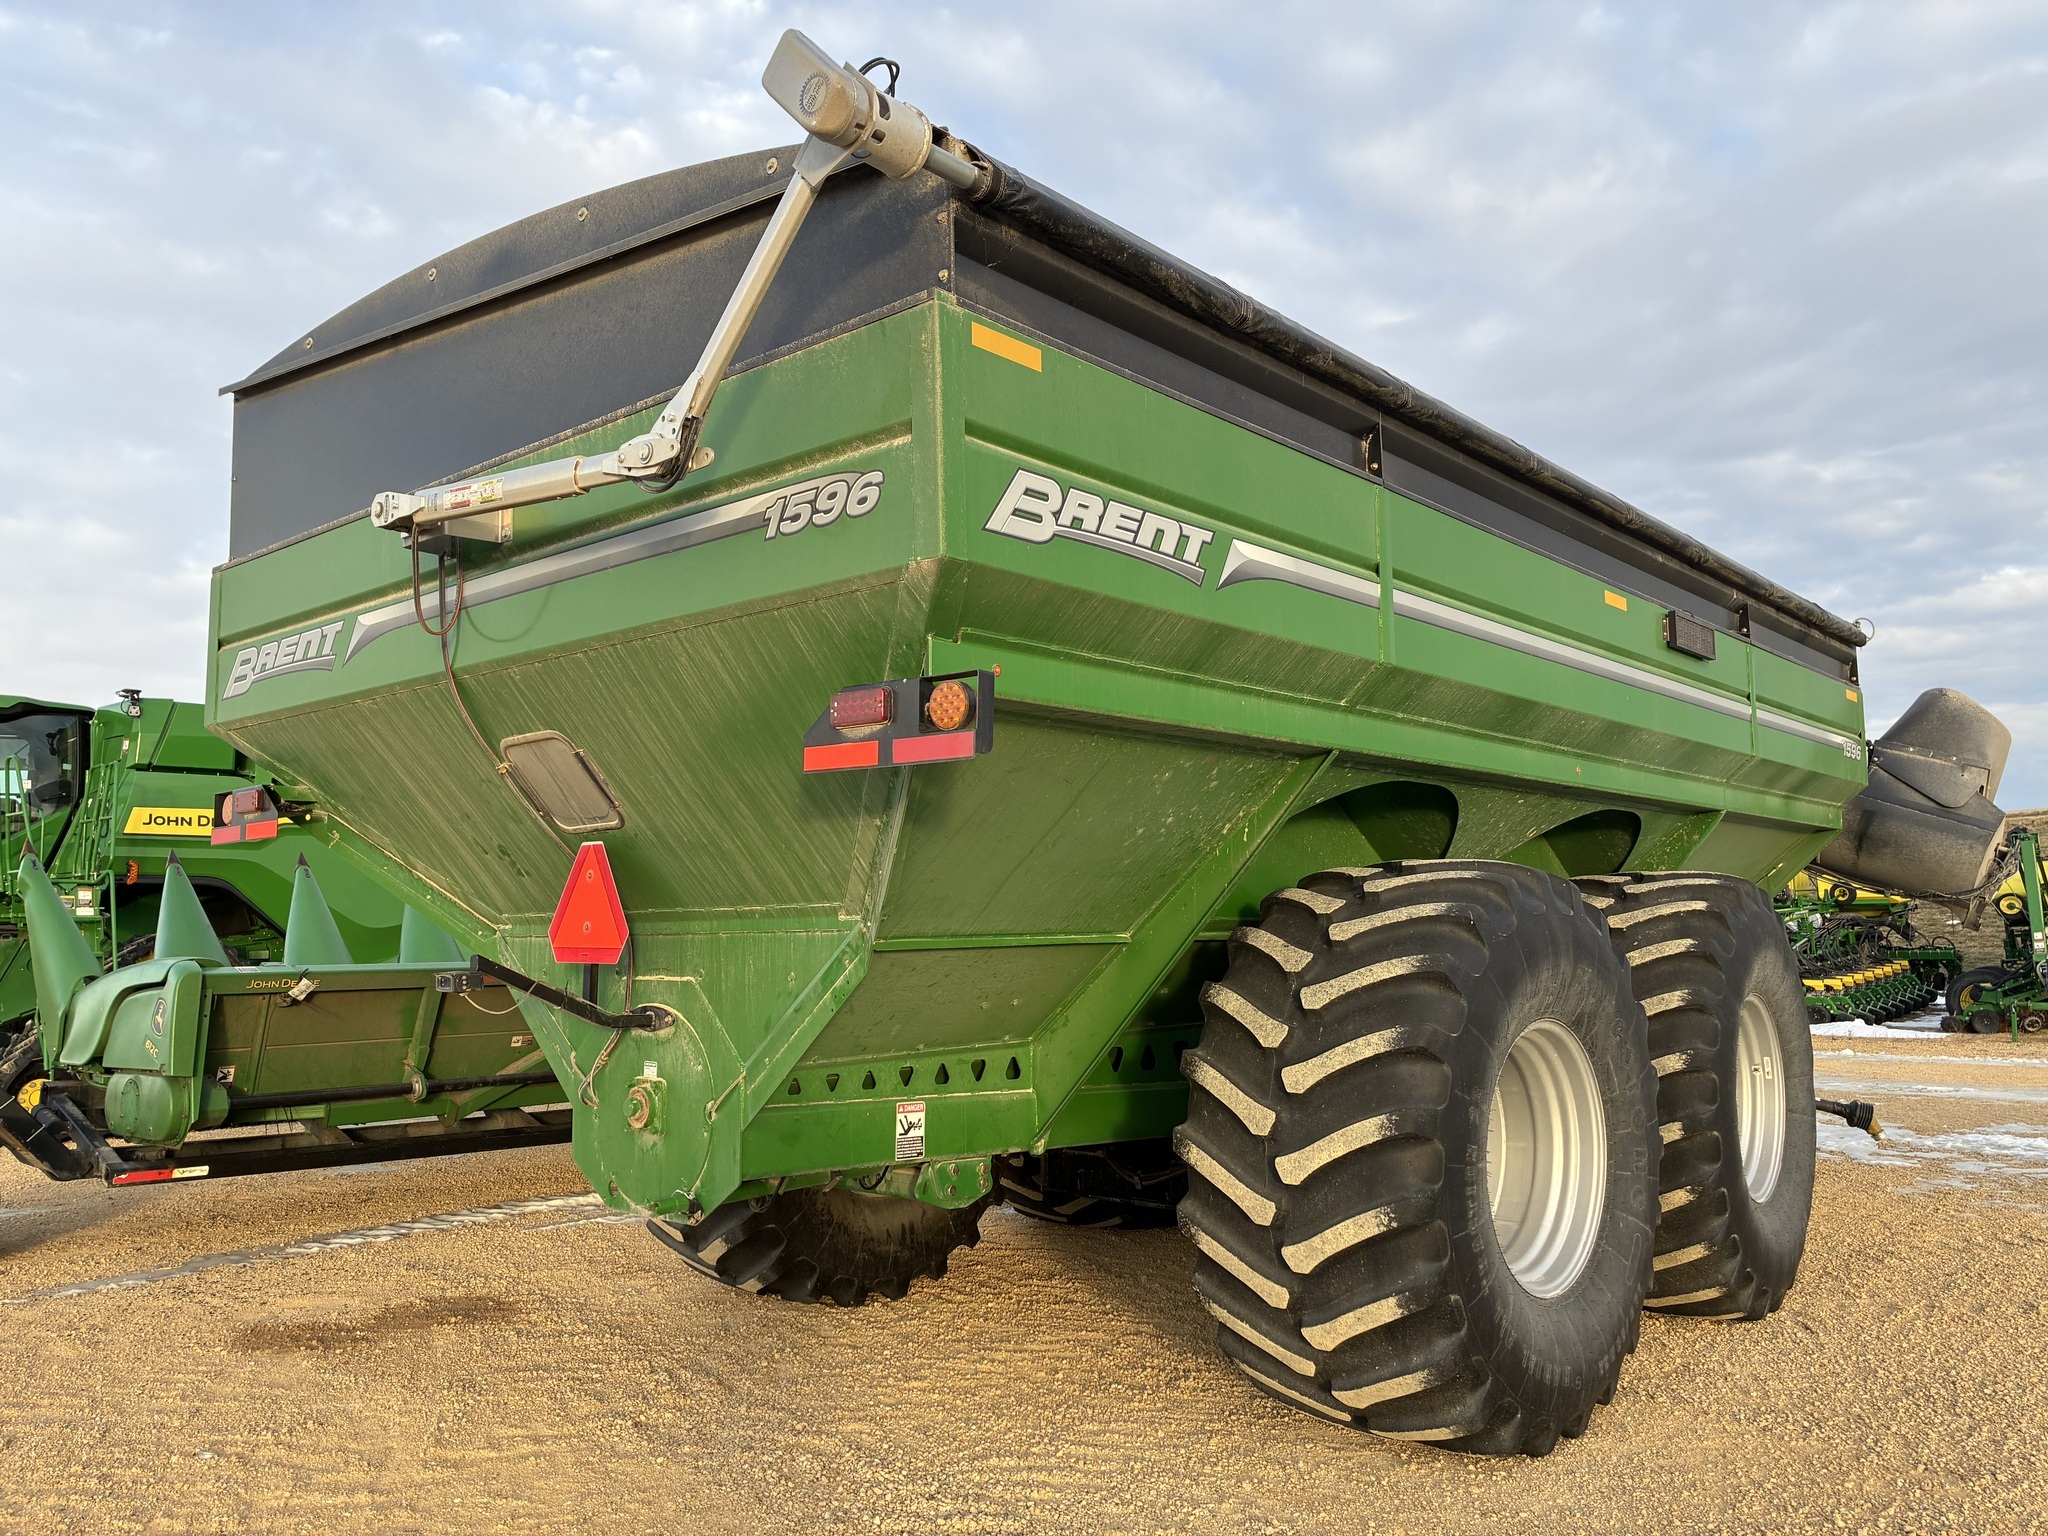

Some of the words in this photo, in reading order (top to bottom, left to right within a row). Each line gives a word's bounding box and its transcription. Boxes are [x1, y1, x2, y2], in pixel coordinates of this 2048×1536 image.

[763, 469, 886, 542] 1596
[981, 467, 1216, 570] BRENT
[222, 619, 345, 700] BRENT
[1842, 741, 1862, 761] 1596
[142, 813, 192, 828] JOHN
[246, 979, 280, 989] JOHN
[145, 1039, 160, 1059] 612C
[904, 1103, 924, 1112] DANGER
